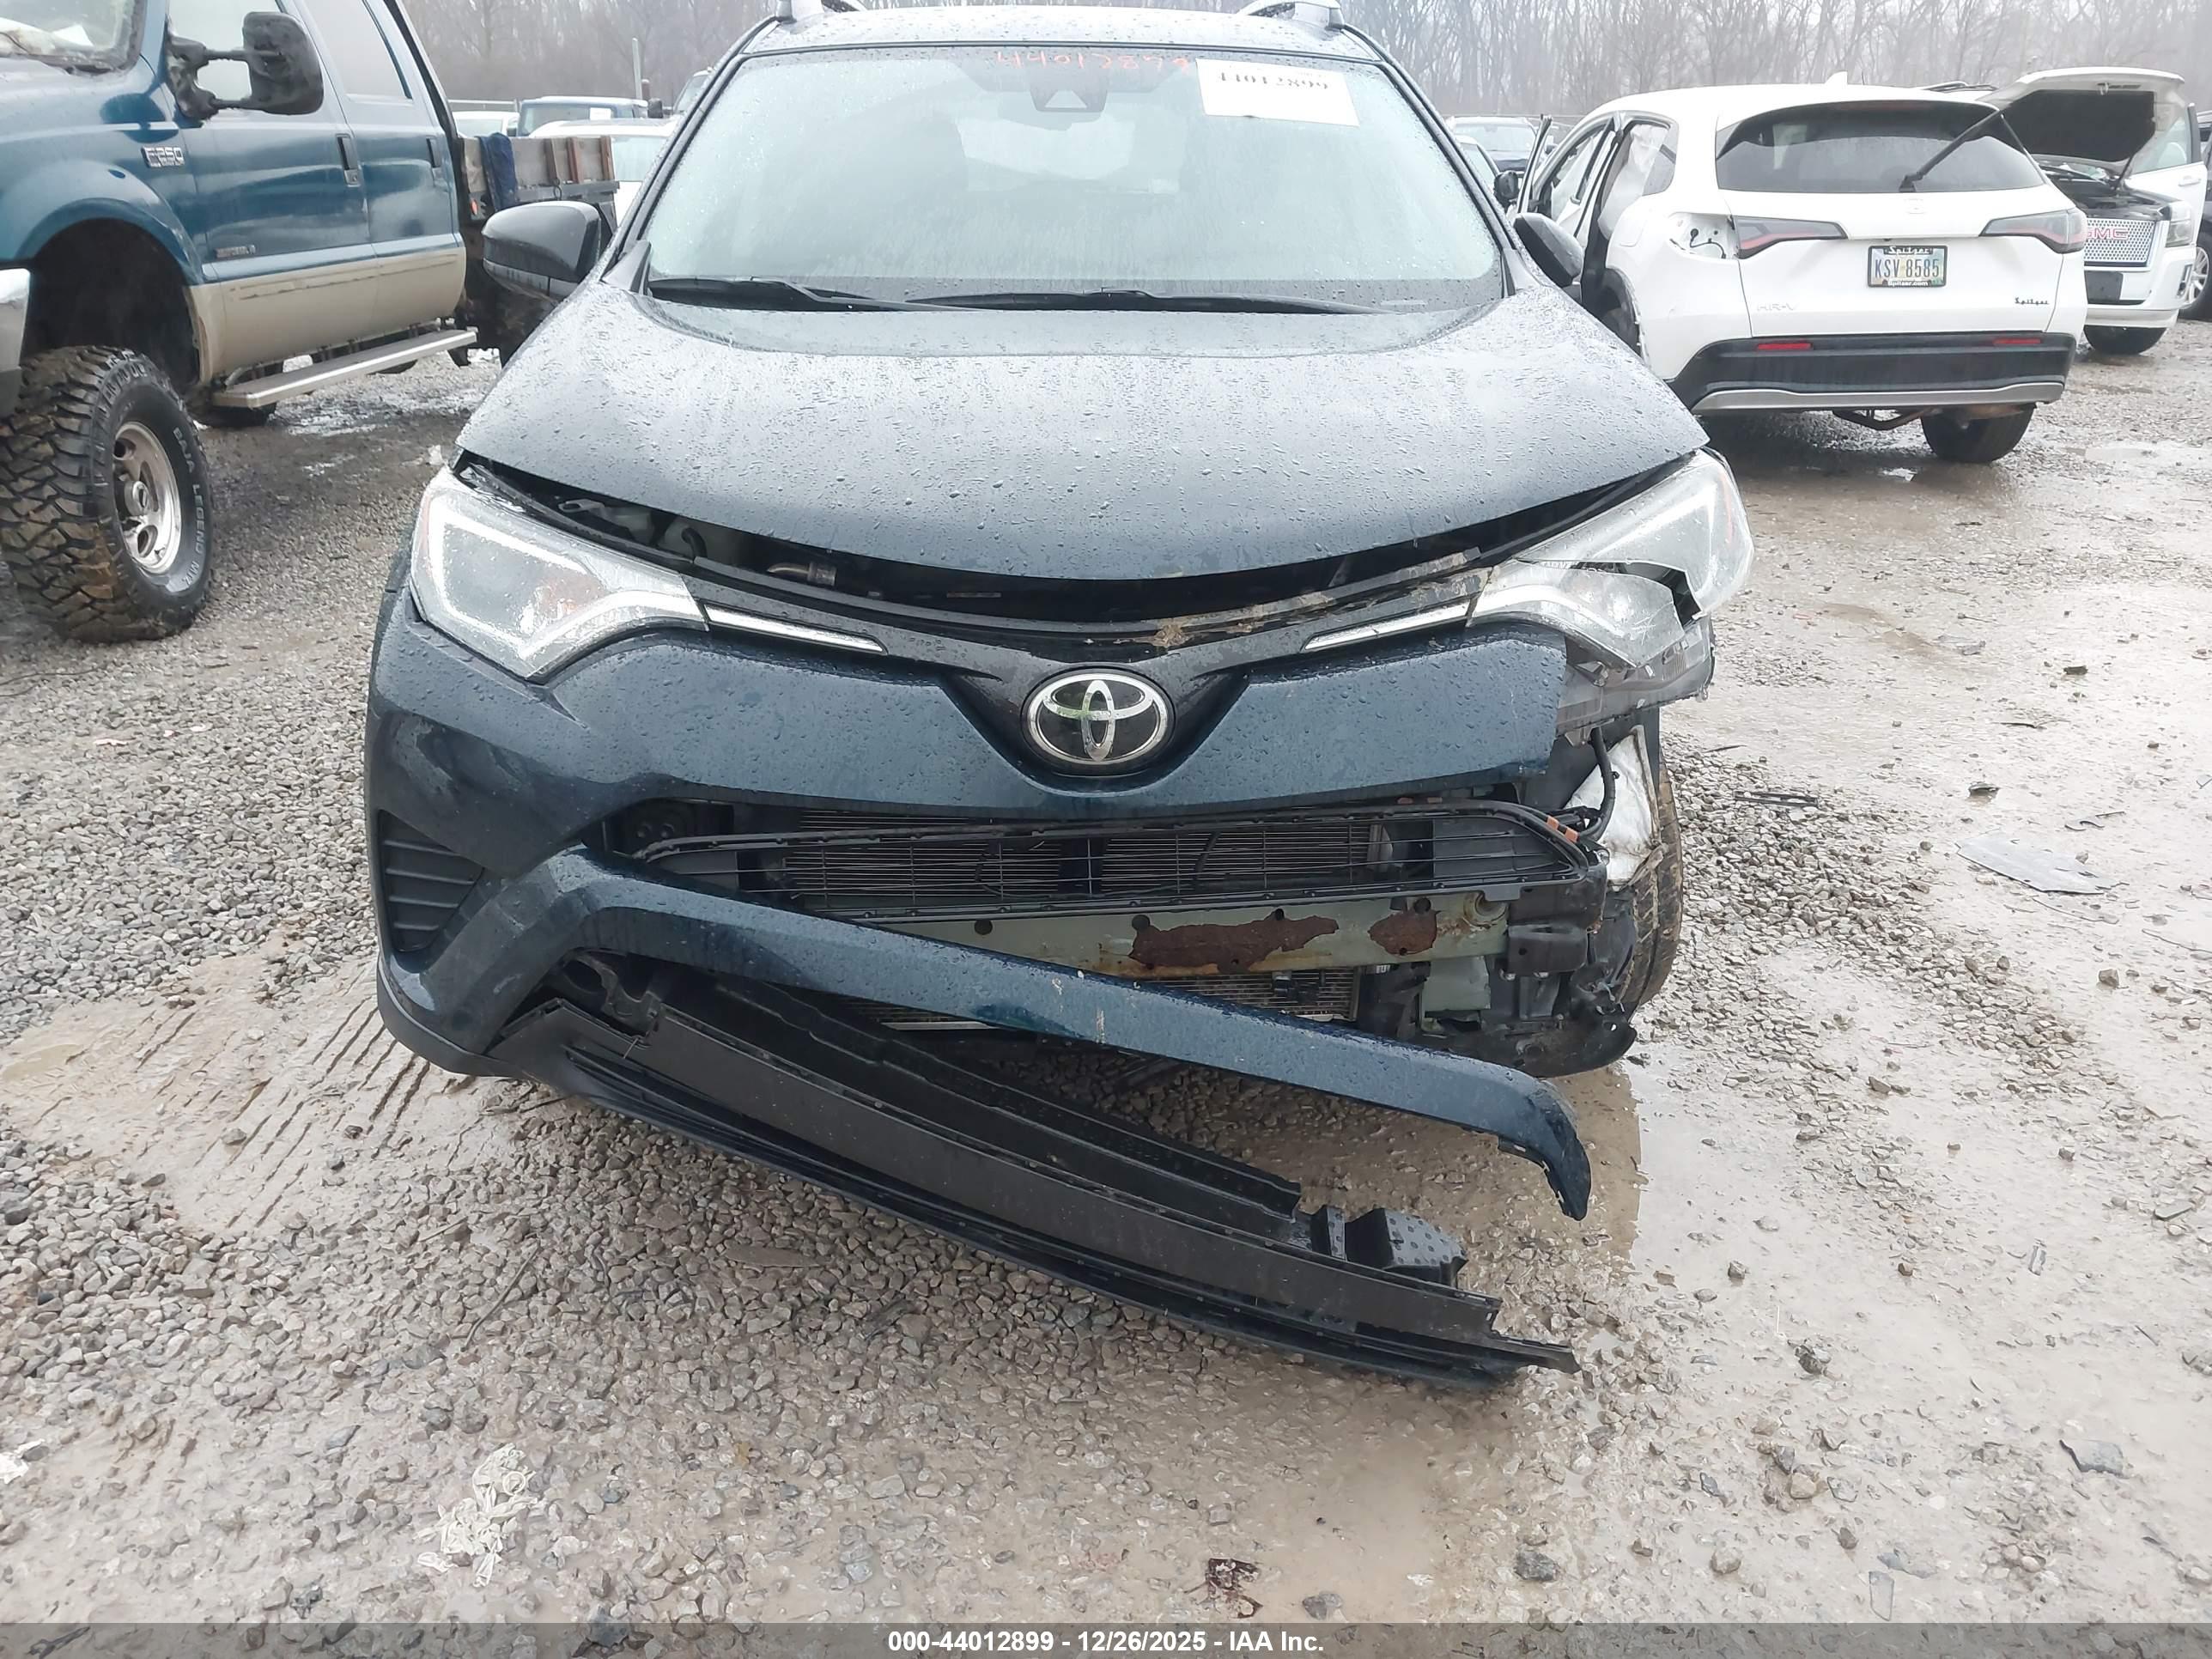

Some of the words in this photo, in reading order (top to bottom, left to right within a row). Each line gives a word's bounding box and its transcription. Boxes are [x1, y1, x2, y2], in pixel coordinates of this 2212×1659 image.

[1875, 258, 1900, 278] KSV
[1905, 258, 1940, 278] 8585
[173, 427, 196, 474] BAJA
[191, 483, 206, 554] LEGEND
